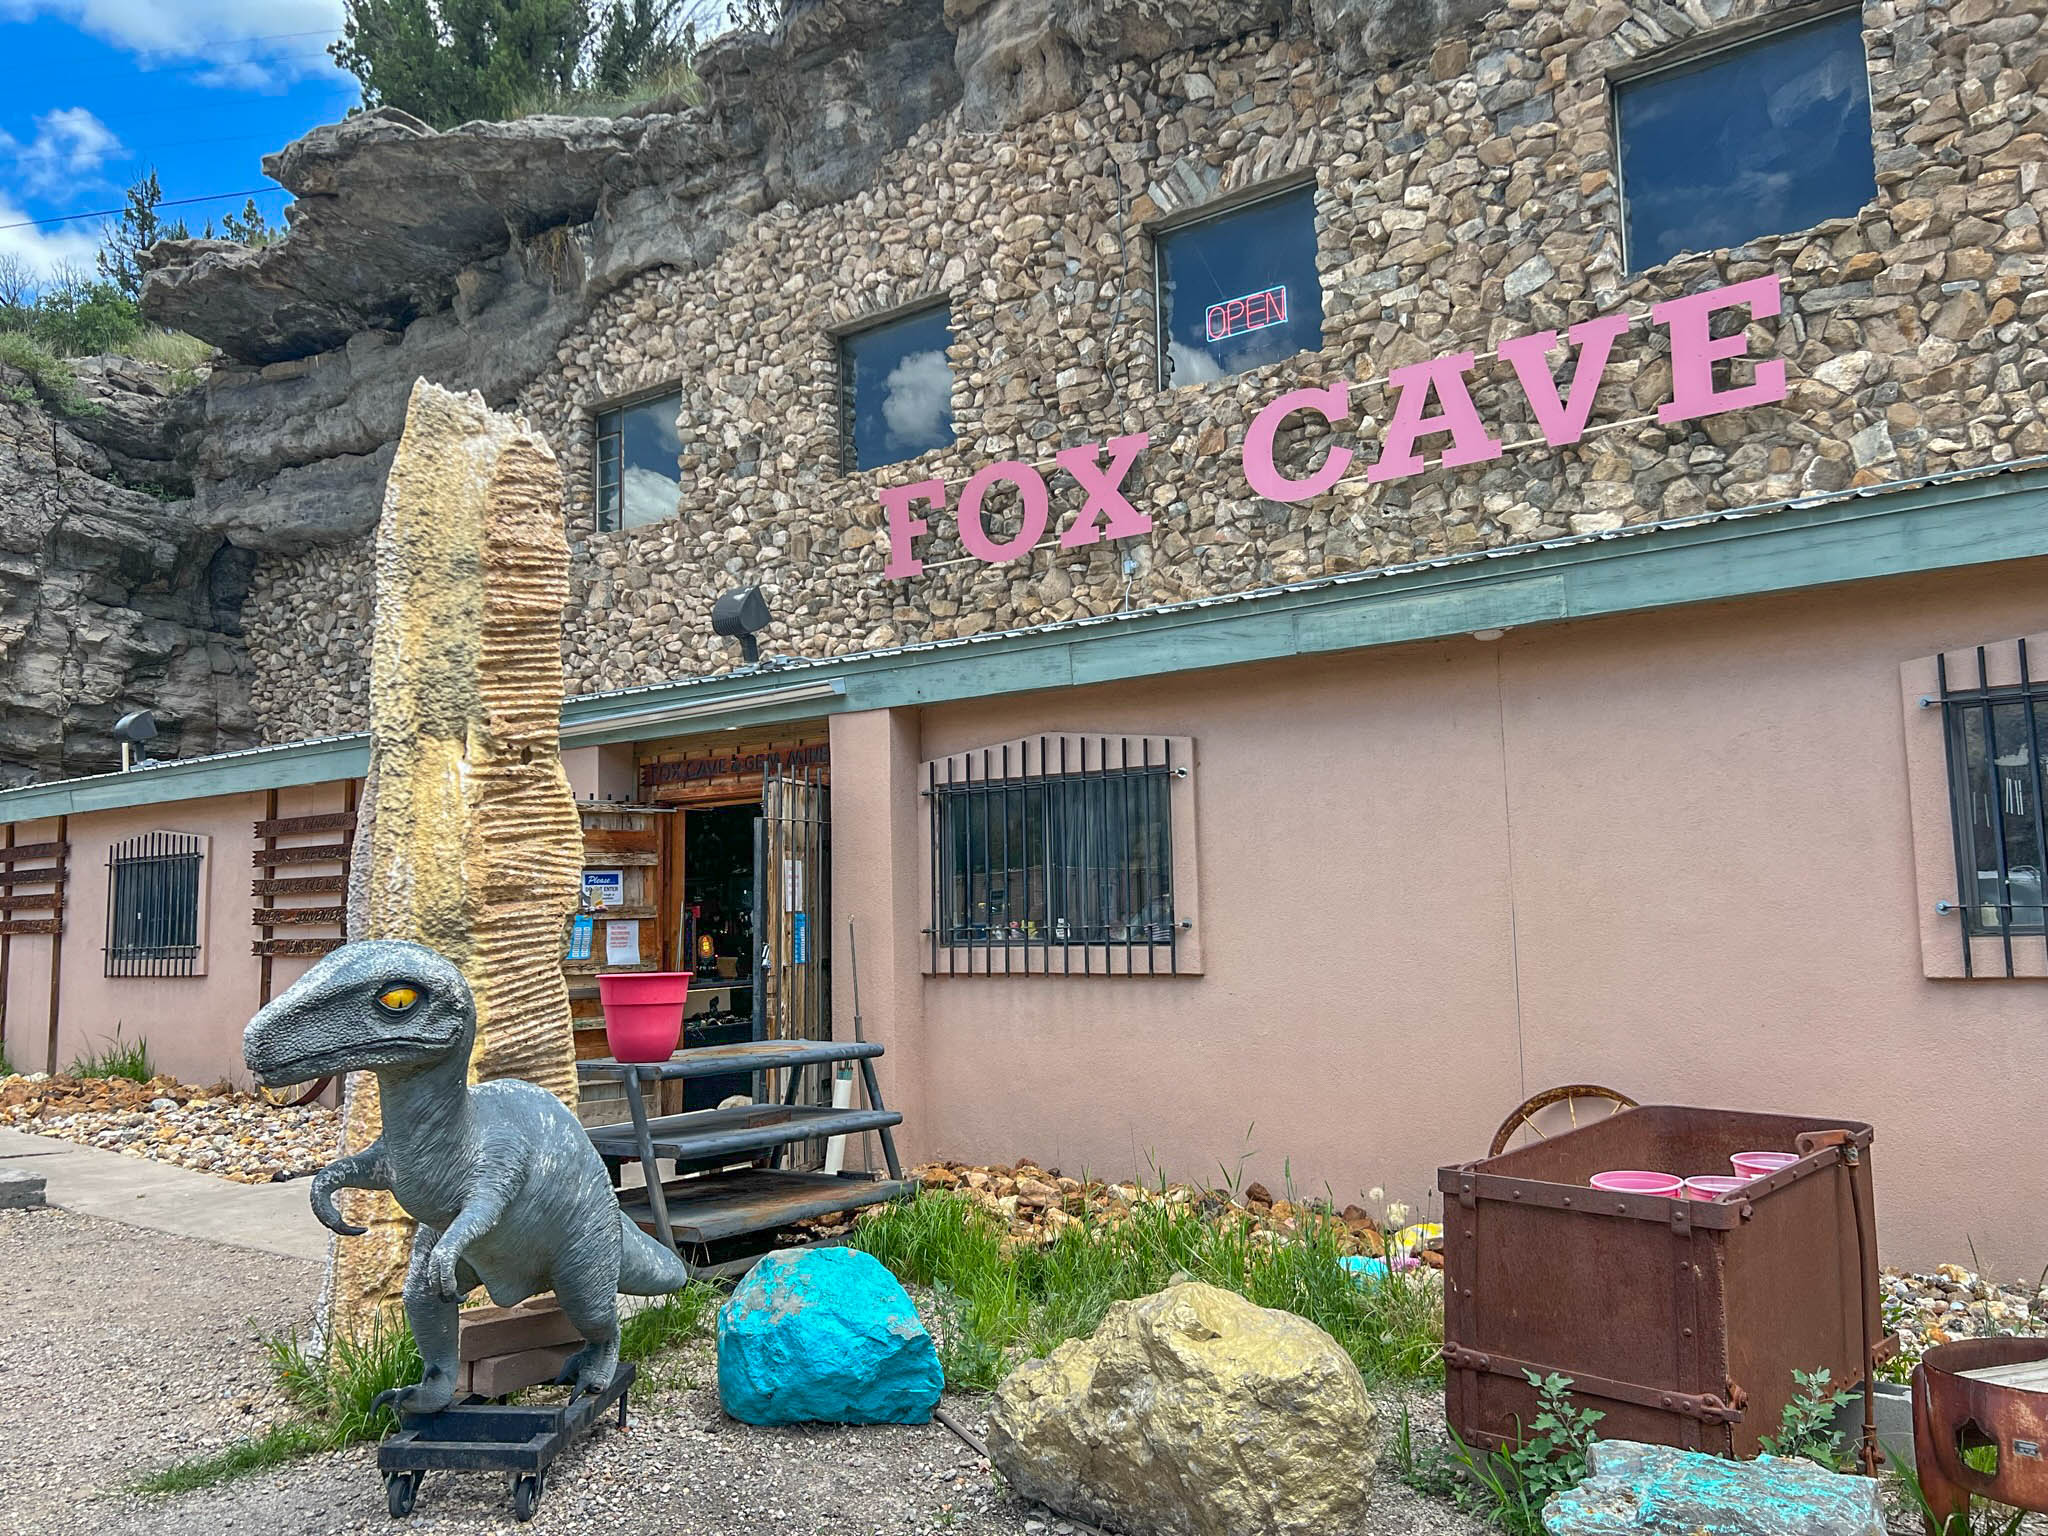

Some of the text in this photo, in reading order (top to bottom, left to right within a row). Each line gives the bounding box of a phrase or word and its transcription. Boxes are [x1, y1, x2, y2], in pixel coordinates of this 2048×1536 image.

[1208, 288, 1285, 339] OPEN
[880, 274, 1787, 580] FOX CAVE
[651, 763, 681, 784] FOX
[686, 758, 727, 780] CAVE
[745, 753, 780, 770] GEM
[259, 879, 294, 893] INDIAN
